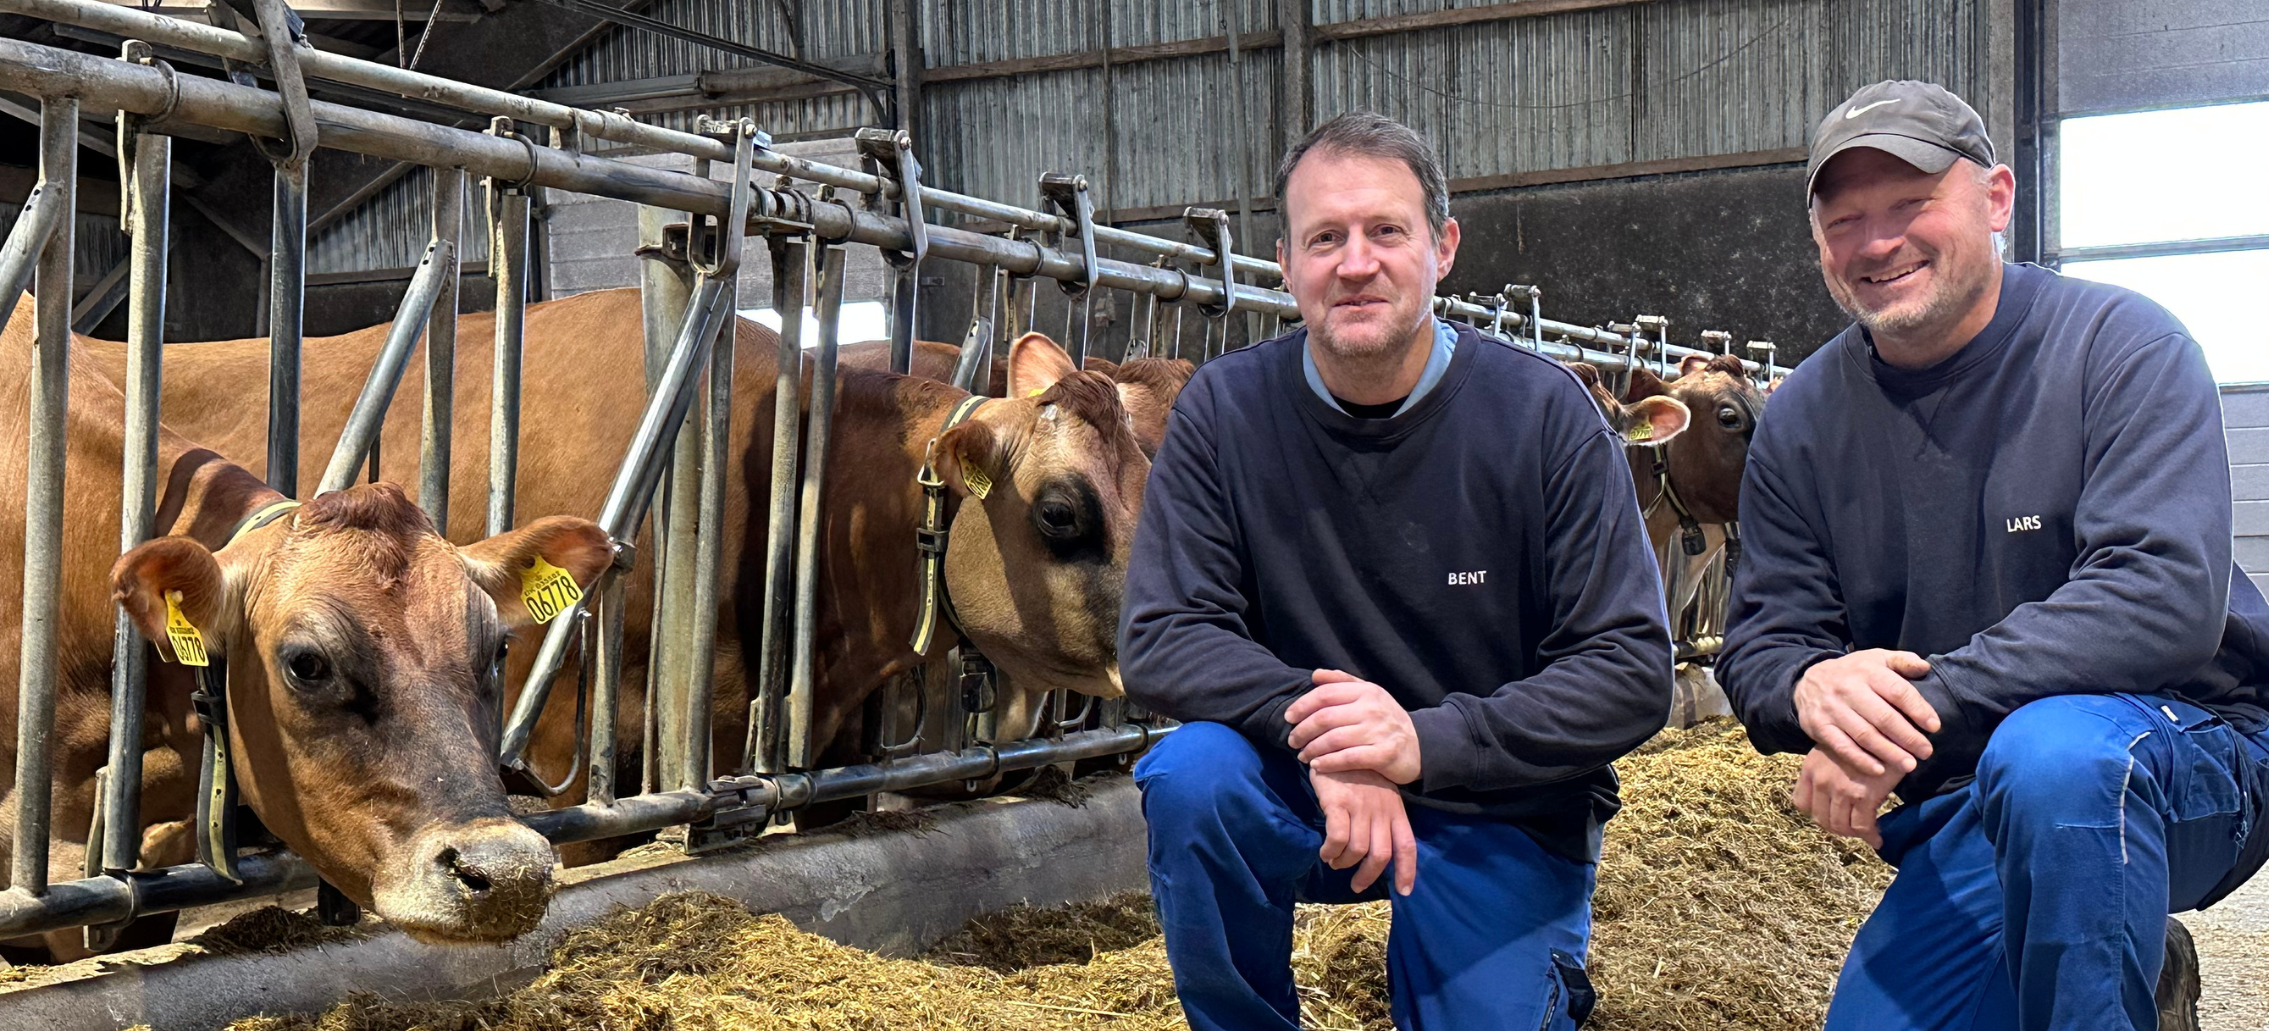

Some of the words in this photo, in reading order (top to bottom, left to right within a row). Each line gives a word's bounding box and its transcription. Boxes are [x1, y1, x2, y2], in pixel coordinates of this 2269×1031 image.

[2006, 515, 2042, 533] LARS
[1448, 570, 1487, 585] BENT
[526, 575, 579, 622] 06778
